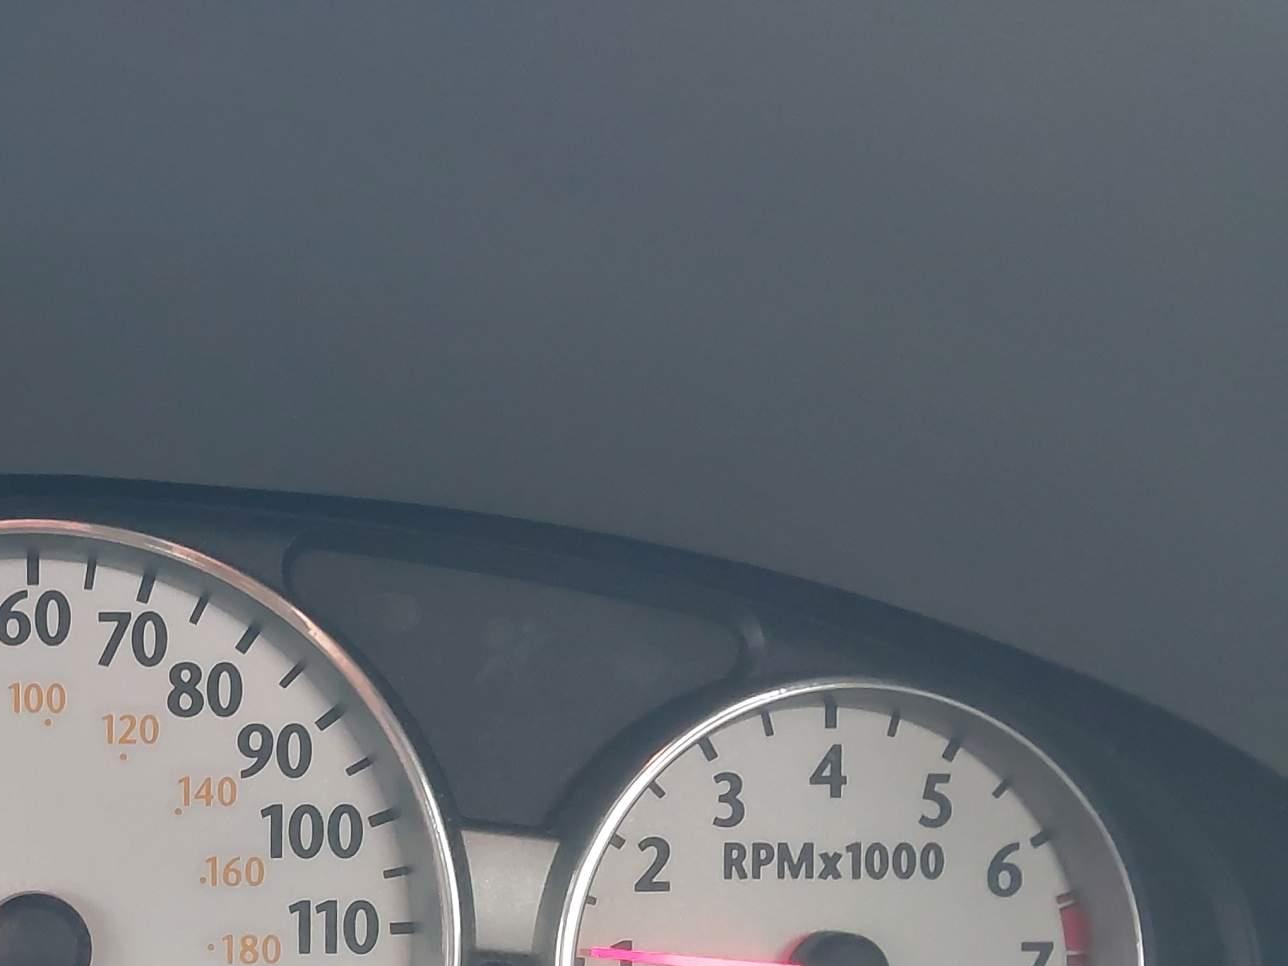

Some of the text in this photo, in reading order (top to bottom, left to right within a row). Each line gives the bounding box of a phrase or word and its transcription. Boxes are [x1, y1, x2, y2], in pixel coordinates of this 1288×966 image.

[97, 611, 168, 667] 70
[8, 682, 66, 714] 100
[166, 661, 243, 718] 80
[102, 714, 160, 745] 120
[236, 723, 313, 779] 90
[177, 776, 238, 807] 140
[810, 743, 847, 798] 4
[712, 772, 746, 828] 3
[919, 773, 953, 828] 5
[260, 803, 364, 859] 100
[204, 856, 265, 887] 160
[634, 837, 670, 892] 2
[722, 842, 945, 881] RPMx1000
[986, 843, 1023, 898] 6
[219, 935, 281, 965] 180
[288, 899, 379, 955] 110
